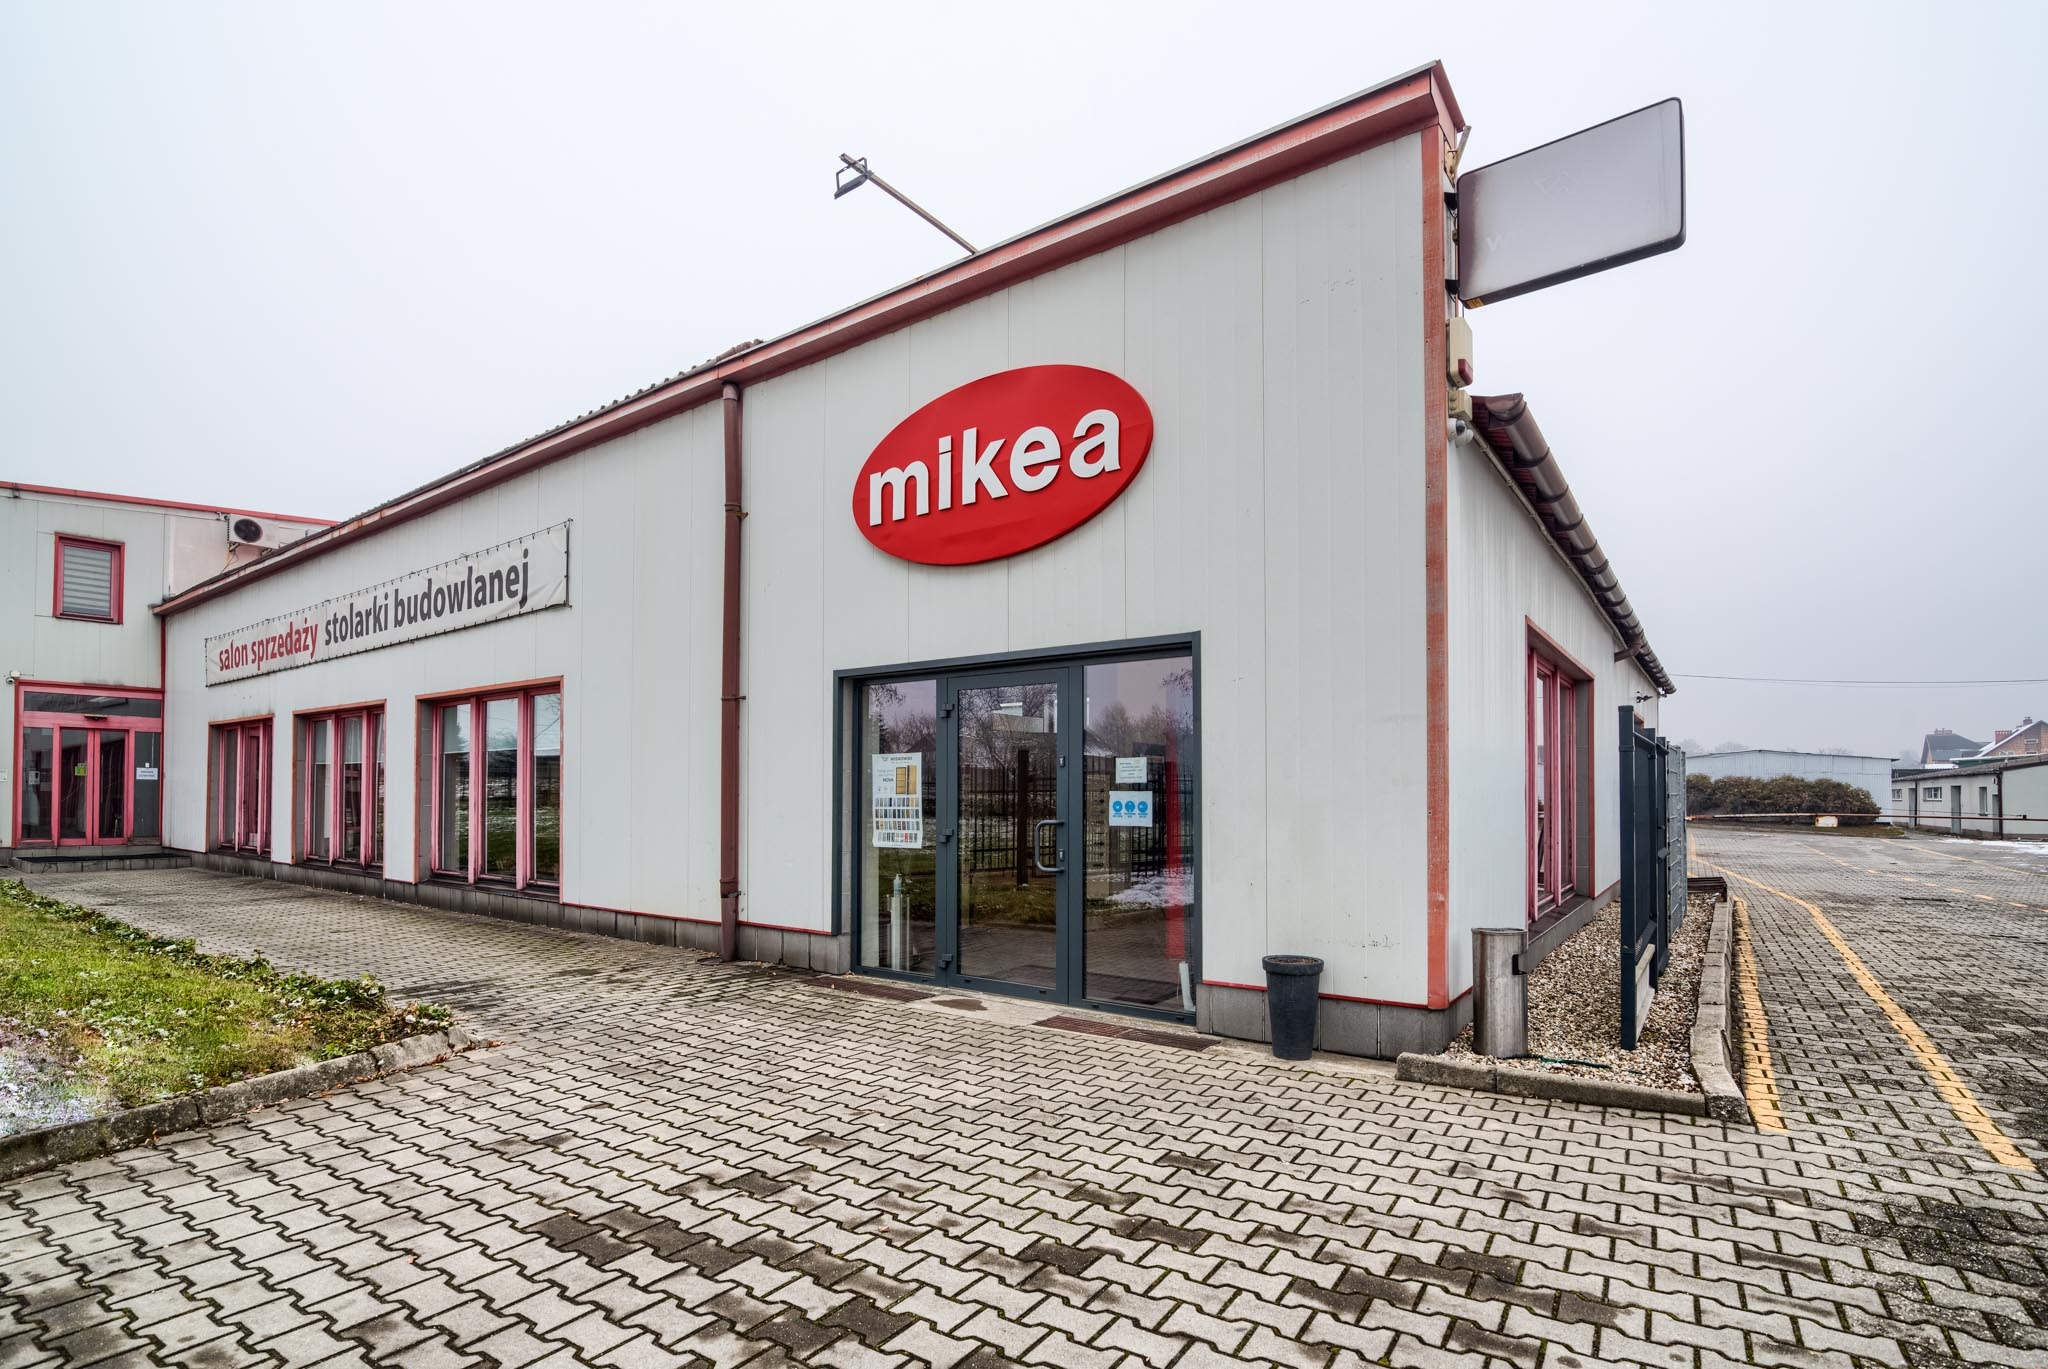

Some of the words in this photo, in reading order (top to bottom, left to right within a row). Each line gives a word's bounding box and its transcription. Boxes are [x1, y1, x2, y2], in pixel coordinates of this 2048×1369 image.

[868, 408, 1121, 527] mikea
[218, 639, 249, 672] salon
[250, 617, 319, 673] sprzedaży
[324, 592, 389, 646] stolarki
[393, 548, 530, 629] budowlanej
